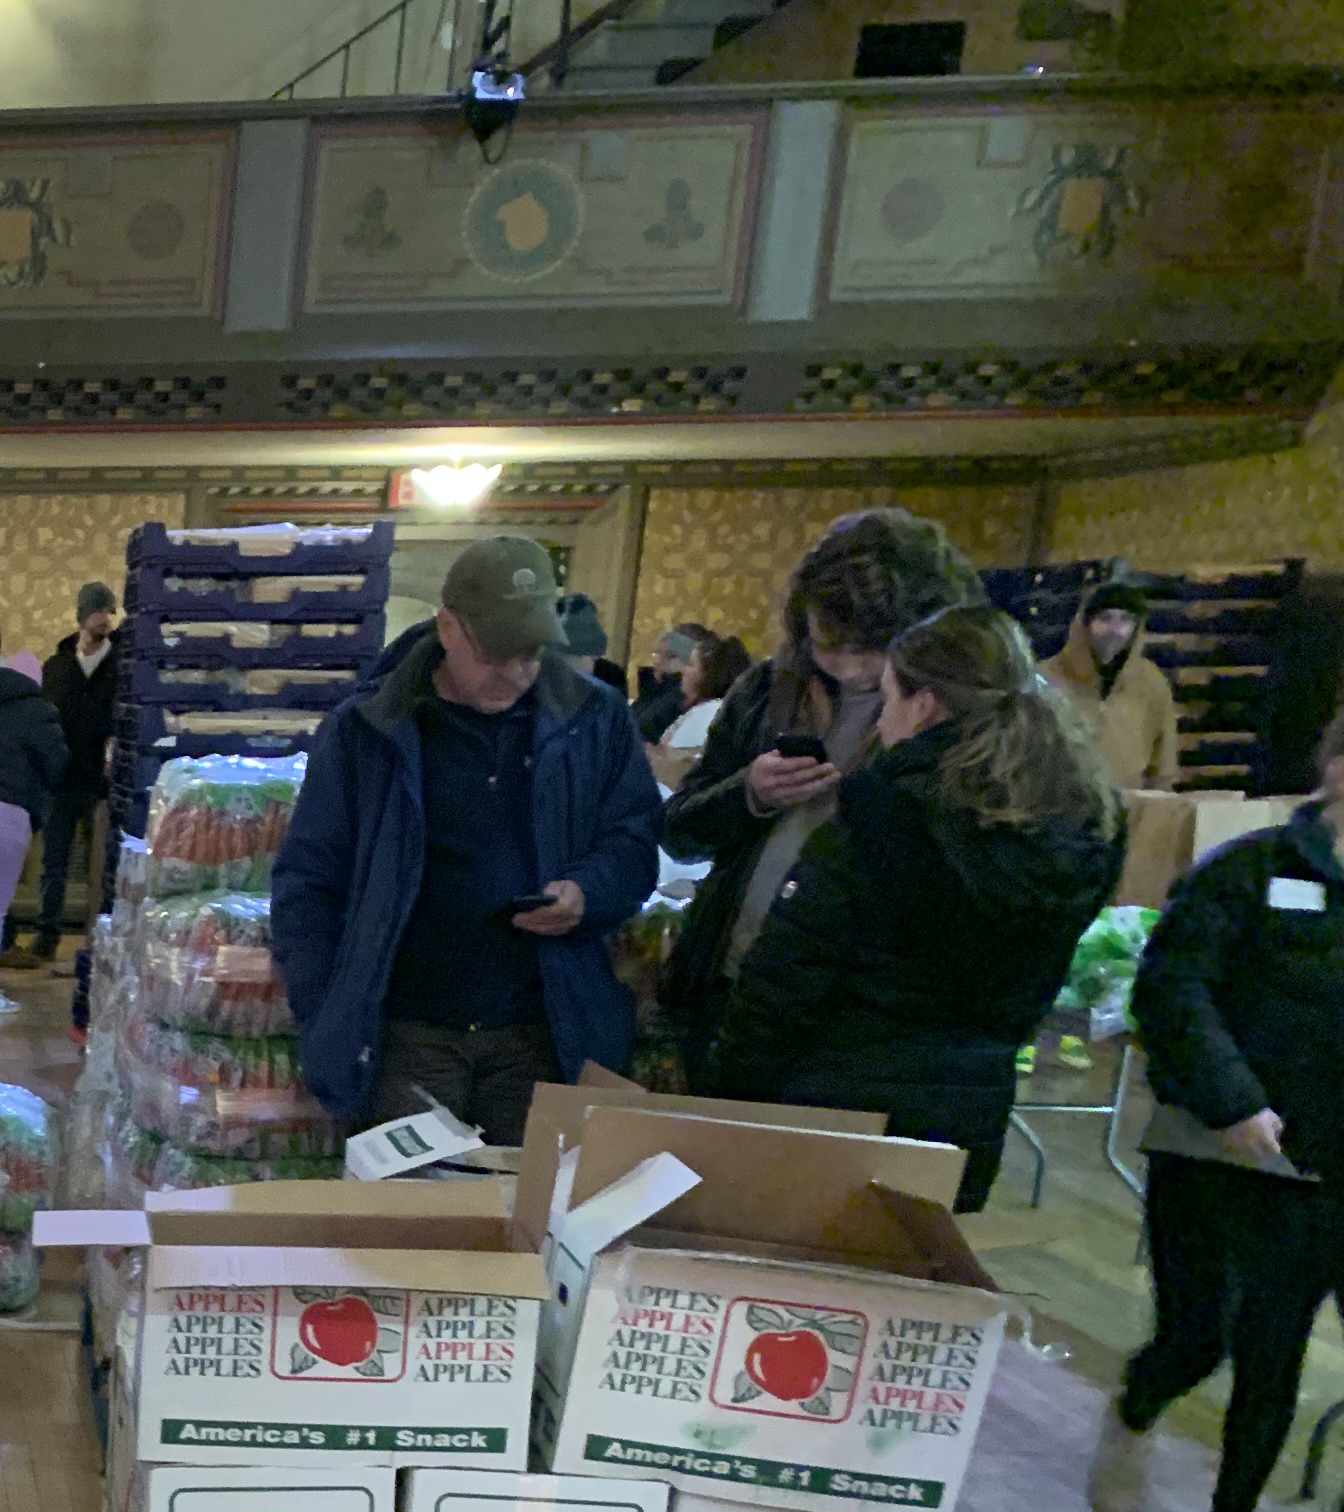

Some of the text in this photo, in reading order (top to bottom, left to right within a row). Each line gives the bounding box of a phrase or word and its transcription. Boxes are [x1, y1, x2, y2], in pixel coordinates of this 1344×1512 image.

[169, 1292, 265, 1314] APPLES
[417, 1297, 516, 1317] APPLES
[166, 1315, 265, 1335] APPLES
[416, 1320, 515, 1340] APPLES
[614, 1306, 716, 1335] APPLES
[879, 1318, 983, 1347] APPLES
[165, 1336, 262, 1357] APPLES
[415, 1341, 515, 1361] APPLES
[608, 1328, 711, 1358] APPLES
[874, 1339, 979, 1369] APPLES
[164, 1357, 261, 1378] APPLES
[413, 1363, 512, 1384] APPLES
[603, 1350, 707, 1380] APPLES
[870, 1362, 974, 1391] APPLES
[599, 1372, 703, 1402] APPLES
[865, 1385, 966, 1414] APPLES
[179, 1424, 488, 1449] America's #1 Snack
[858, 1407, 961, 1437] APPLES
[602, 1441, 925, 1502] America's #1 Snack
